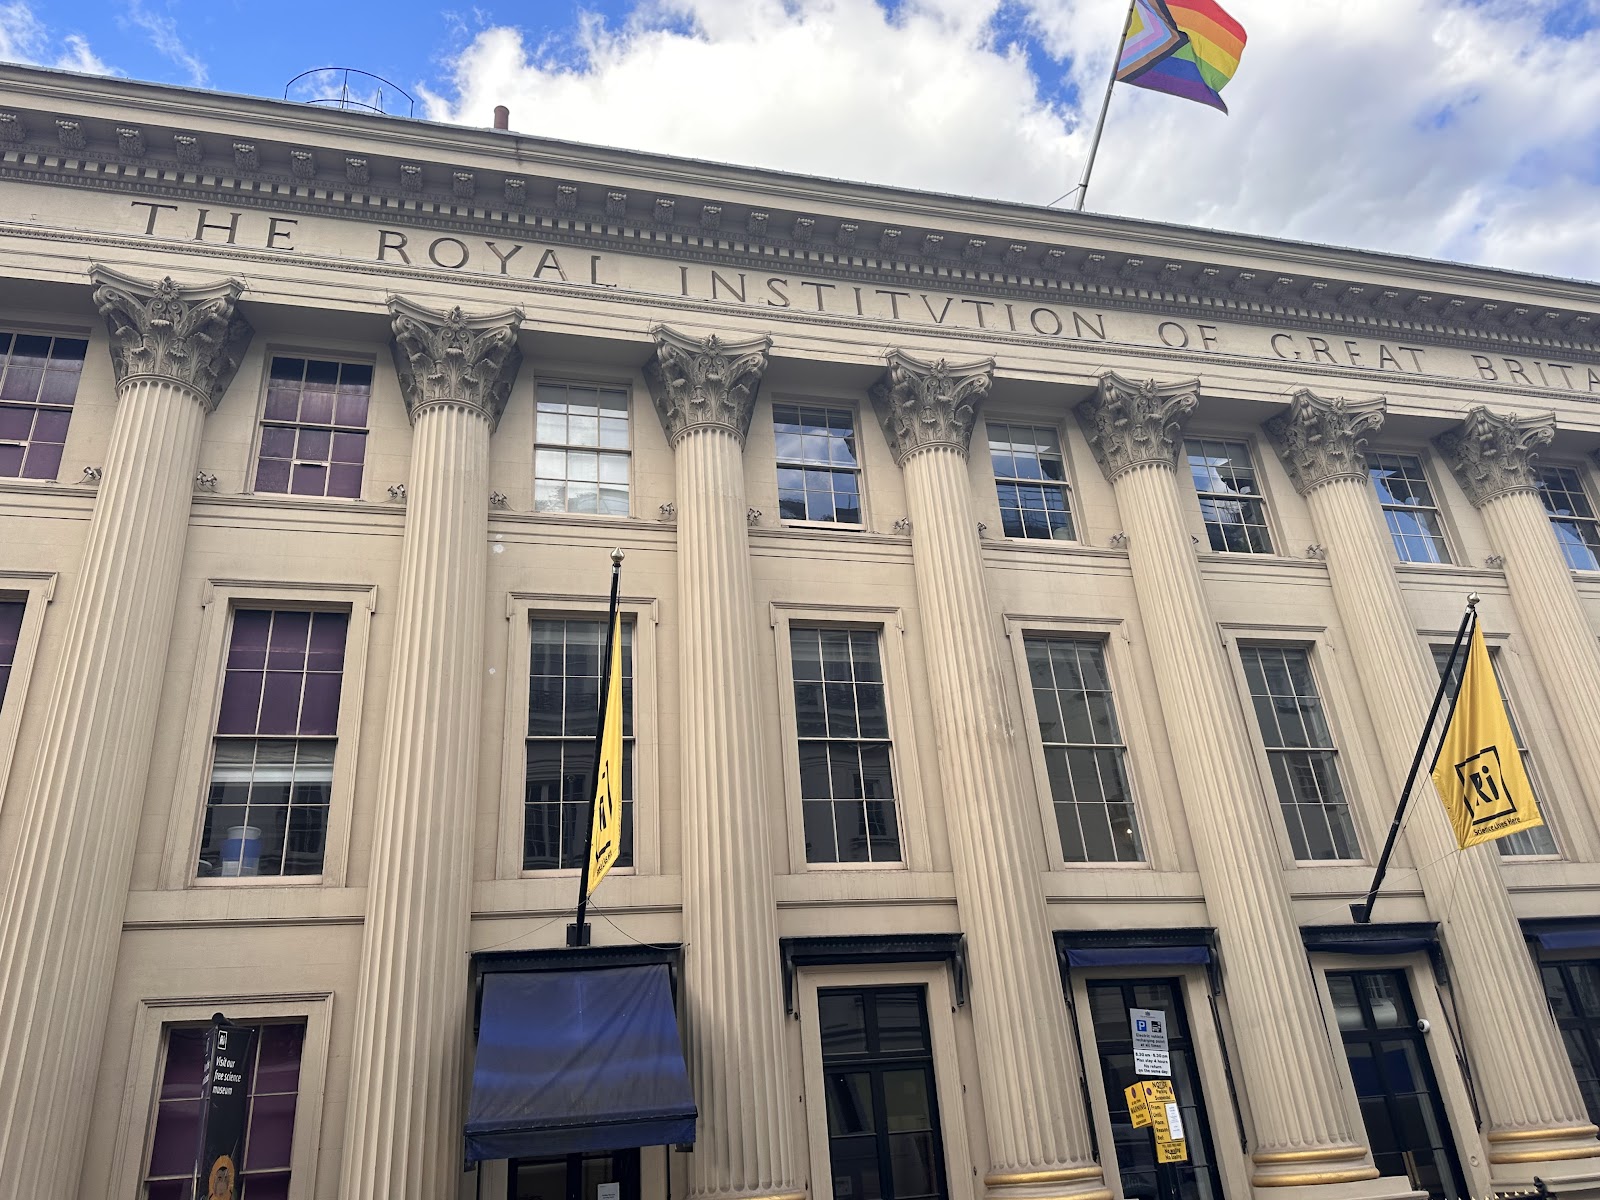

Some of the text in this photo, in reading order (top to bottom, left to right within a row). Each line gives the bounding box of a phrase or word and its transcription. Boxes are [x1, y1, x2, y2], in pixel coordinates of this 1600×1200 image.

[131, 201, 298, 251] THE
[378, 229, 617, 288] ROYAL
[678, 266, 1107, 340] INSTITVTION
[1158, 321, 1218, 351] OF
[1270, 333, 1426, 373] GREAT
[1470, 765, 1500, 806] Ri
[1473, 816, 1521, 836] Science Lives Here
[216, 1056, 236, 1068] Visit our
[213, 1069, 242, 1083] free science
[212, 1085, 233, 1095] museum
